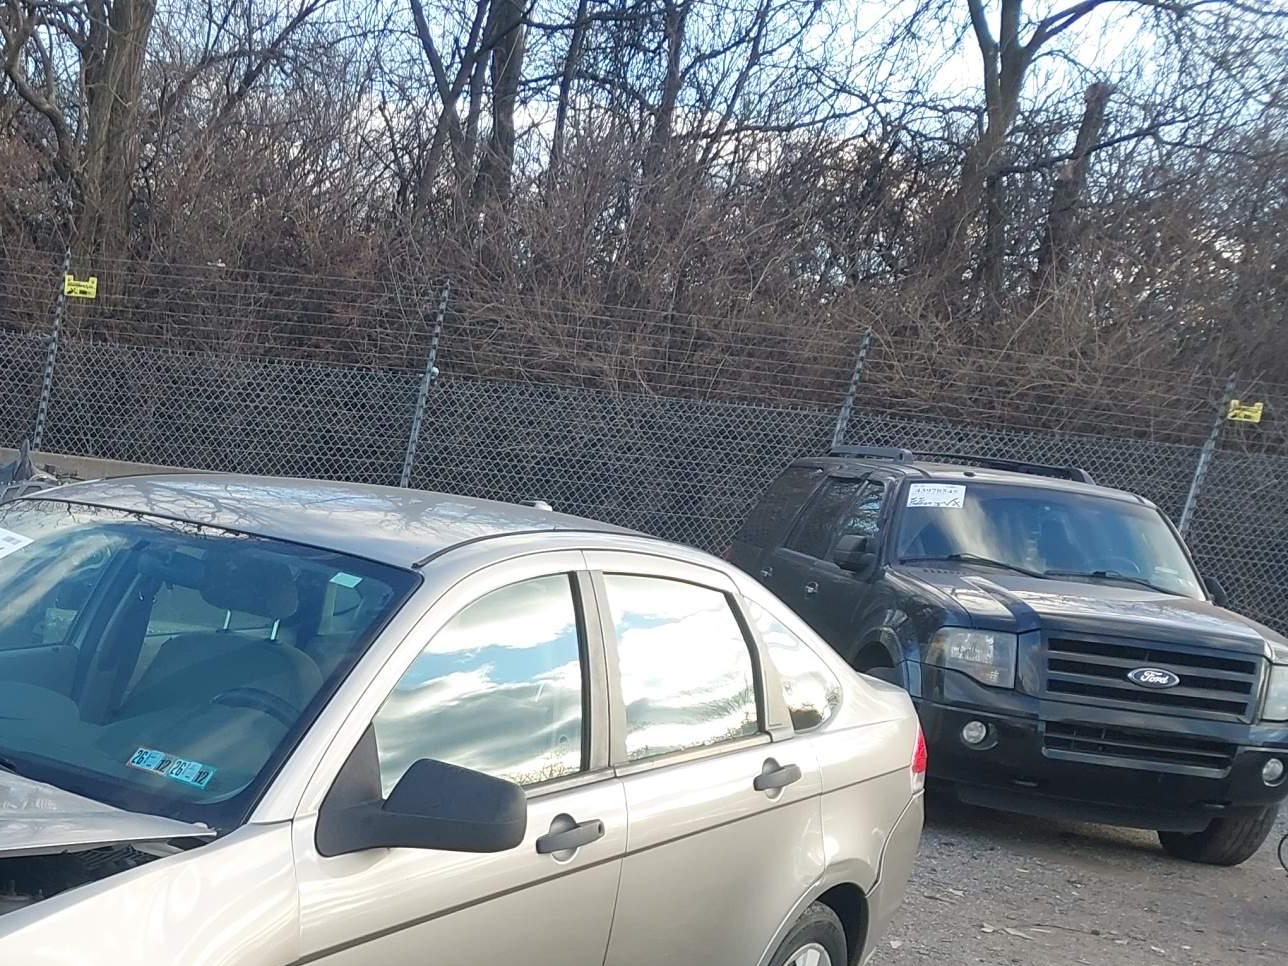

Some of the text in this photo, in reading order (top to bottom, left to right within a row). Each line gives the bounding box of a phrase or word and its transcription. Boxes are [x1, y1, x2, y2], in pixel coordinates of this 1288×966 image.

[132, 749, 172, 774] 26 12
[171, 760, 209, 785] 26 12
